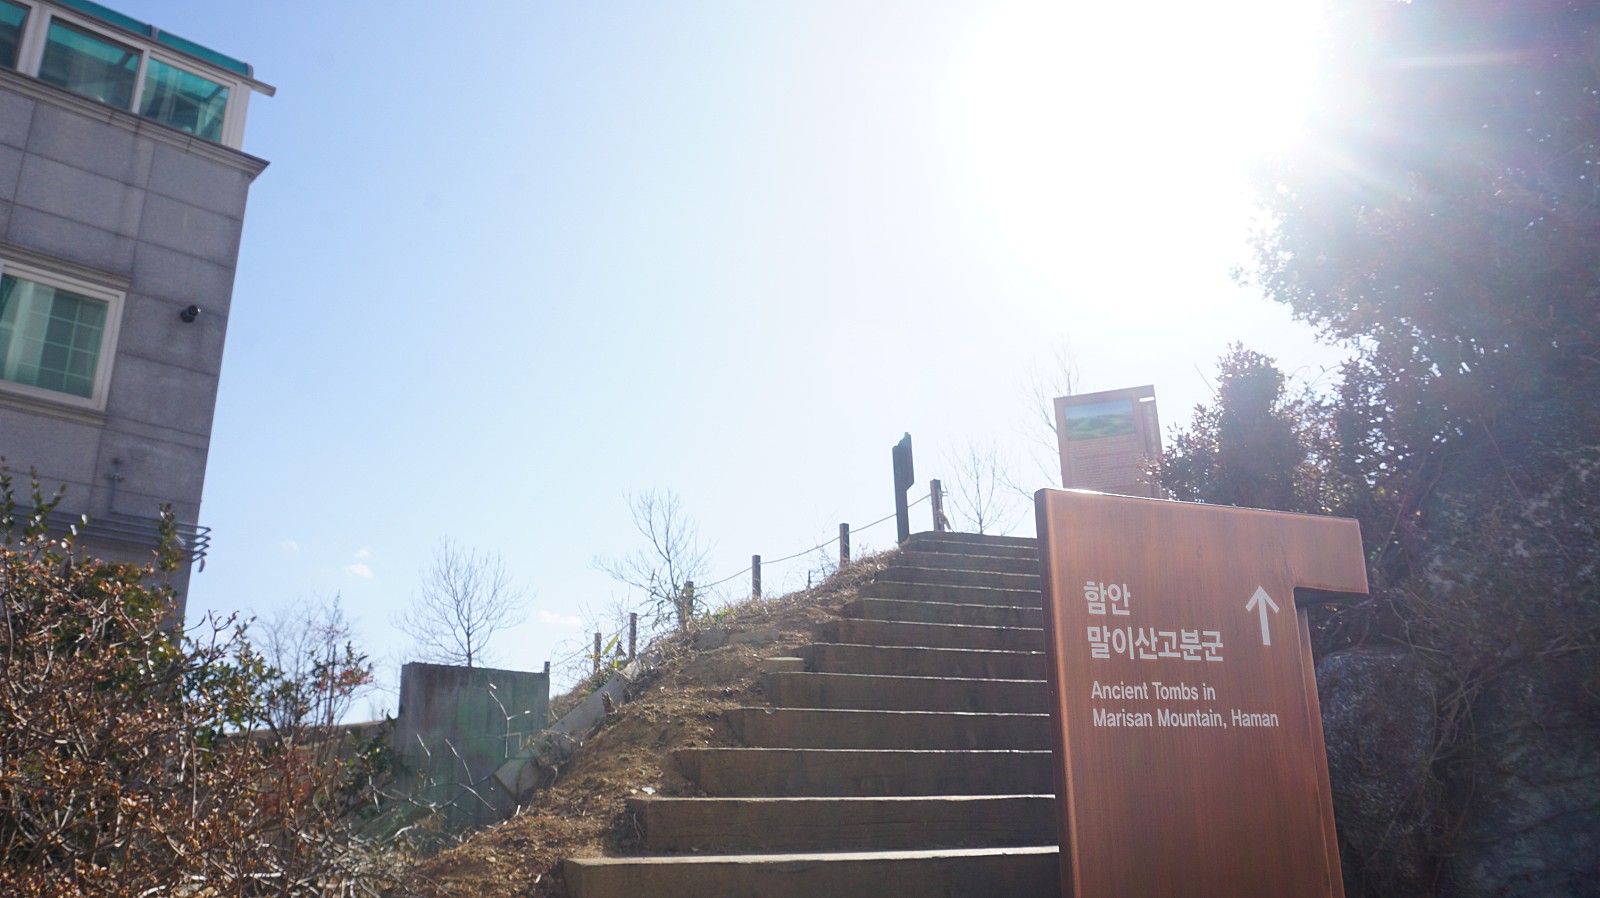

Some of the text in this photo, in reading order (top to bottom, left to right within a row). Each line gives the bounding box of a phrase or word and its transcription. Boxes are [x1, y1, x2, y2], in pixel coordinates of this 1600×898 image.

[1083, 581, 1131, 616] 함안
[1087, 625, 1224, 662] 말이산고분군
[1091, 680, 1216, 701] Ancient Tombs in
[1092, 708, 1279, 729] Marisan Mountain, Haman
